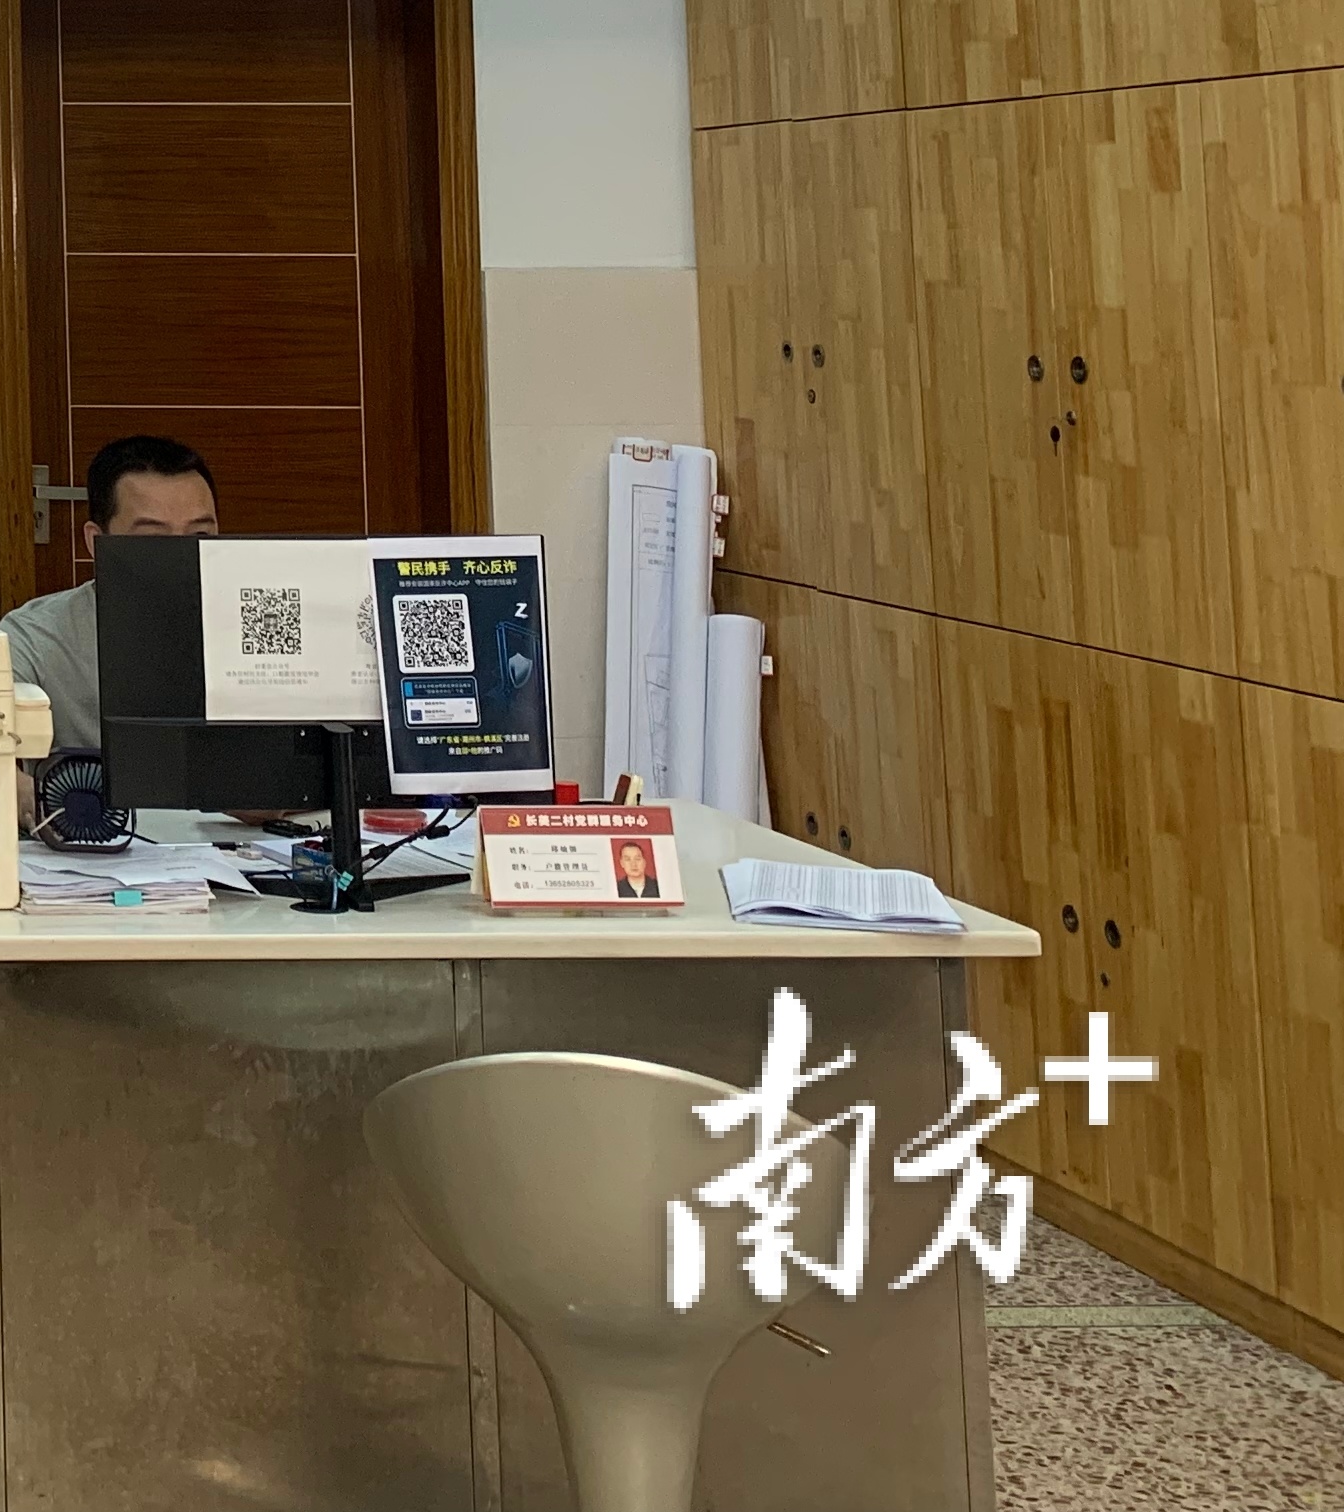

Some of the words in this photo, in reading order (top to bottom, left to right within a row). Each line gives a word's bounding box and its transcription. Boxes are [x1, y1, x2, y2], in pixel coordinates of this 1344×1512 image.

[397, 561, 451, 577] 警民携手
[463, 559, 518, 575] 齐心反诈
[526, 815, 648, 827] 长美二村党群服务中心
